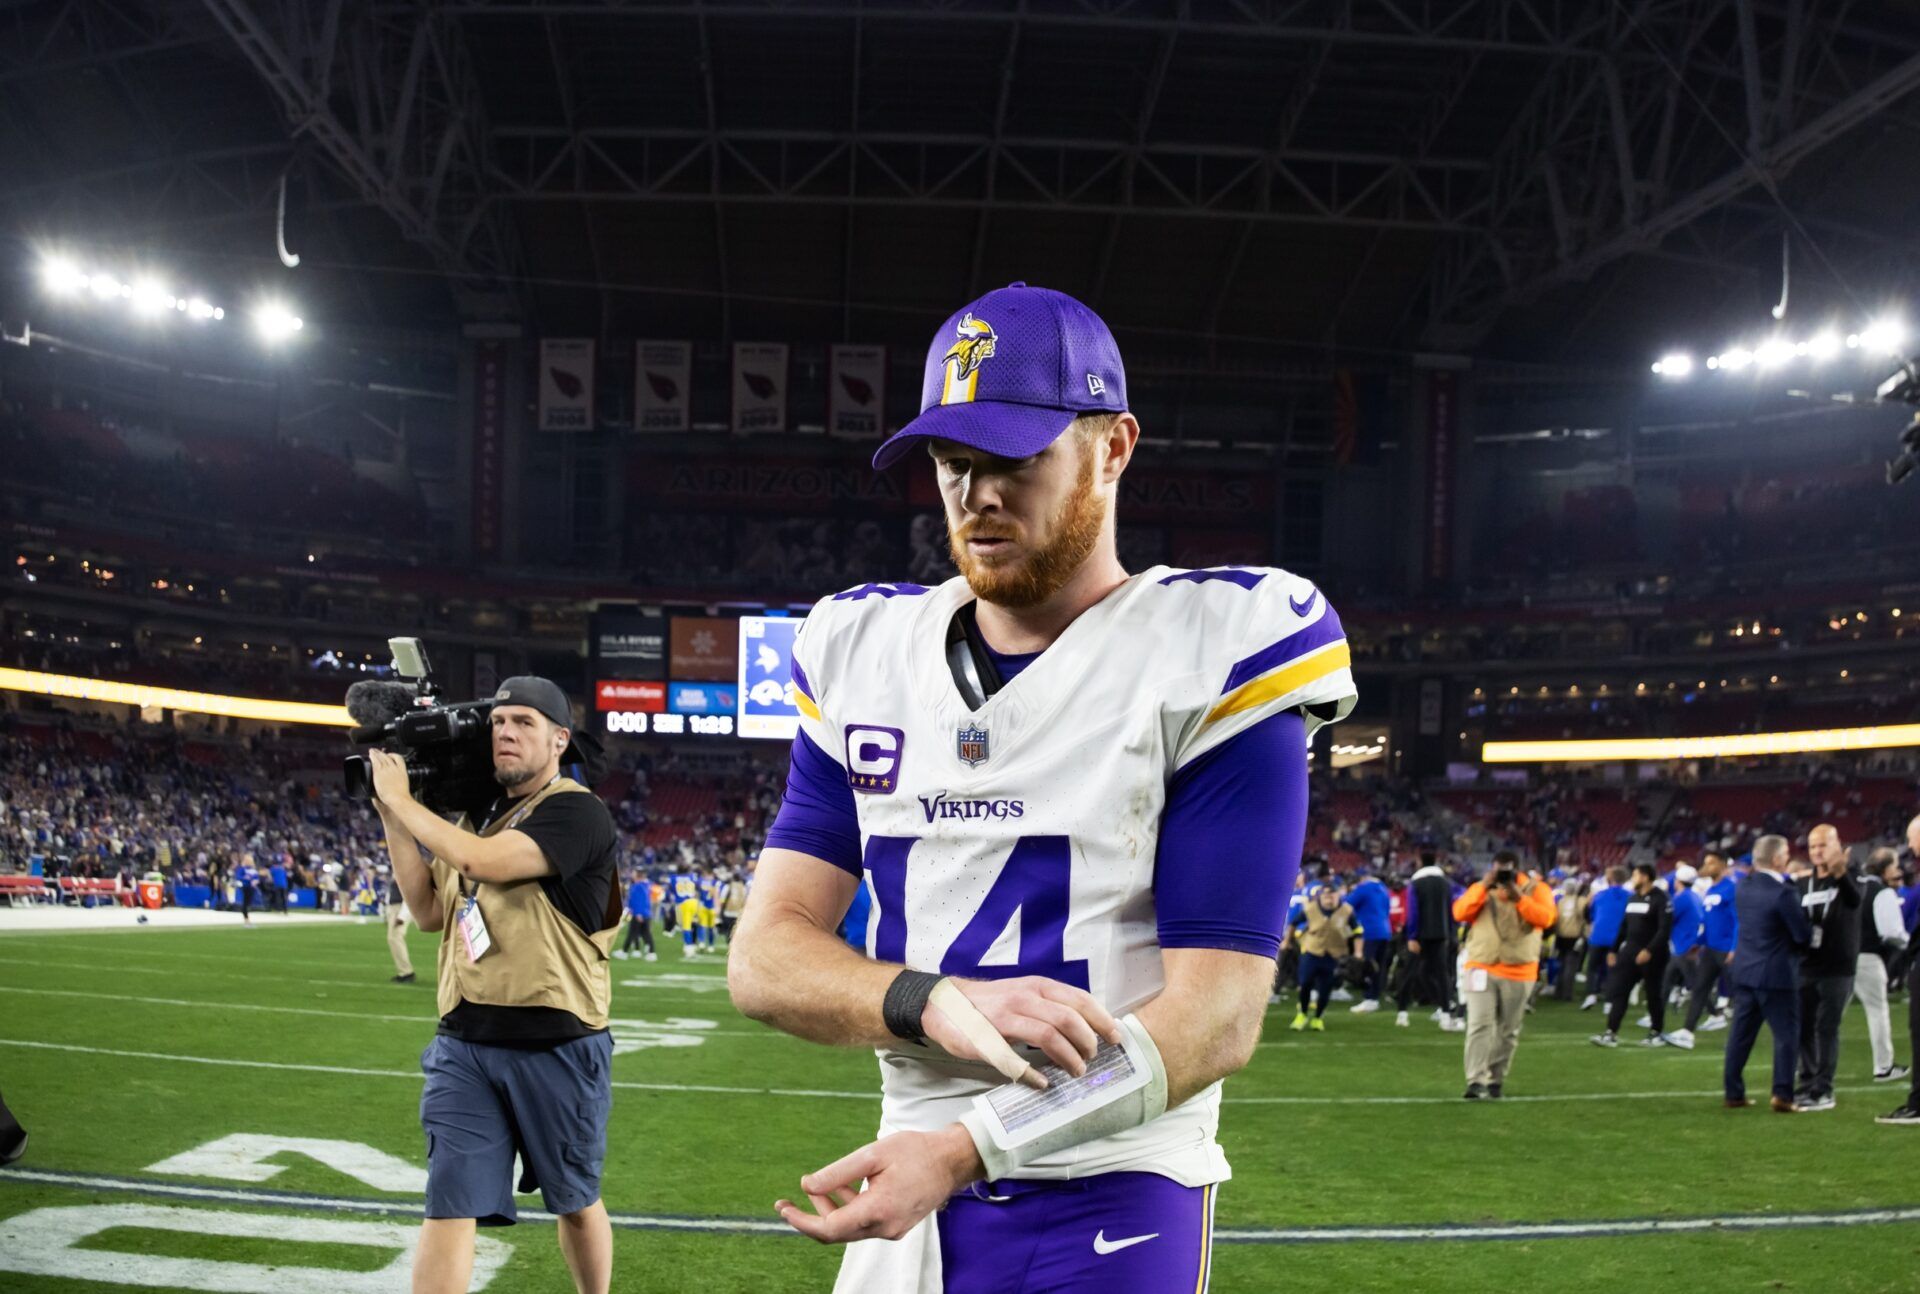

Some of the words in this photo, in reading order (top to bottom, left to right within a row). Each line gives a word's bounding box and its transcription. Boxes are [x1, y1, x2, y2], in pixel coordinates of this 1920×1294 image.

[670, 464, 901, 500] ARIZONA
[848, 729, 897, 775] C
[961, 743, 984, 760] NFL
[918, 790, 1024, 823] VIKINGS
[863, 835, 1092, 994] 14
